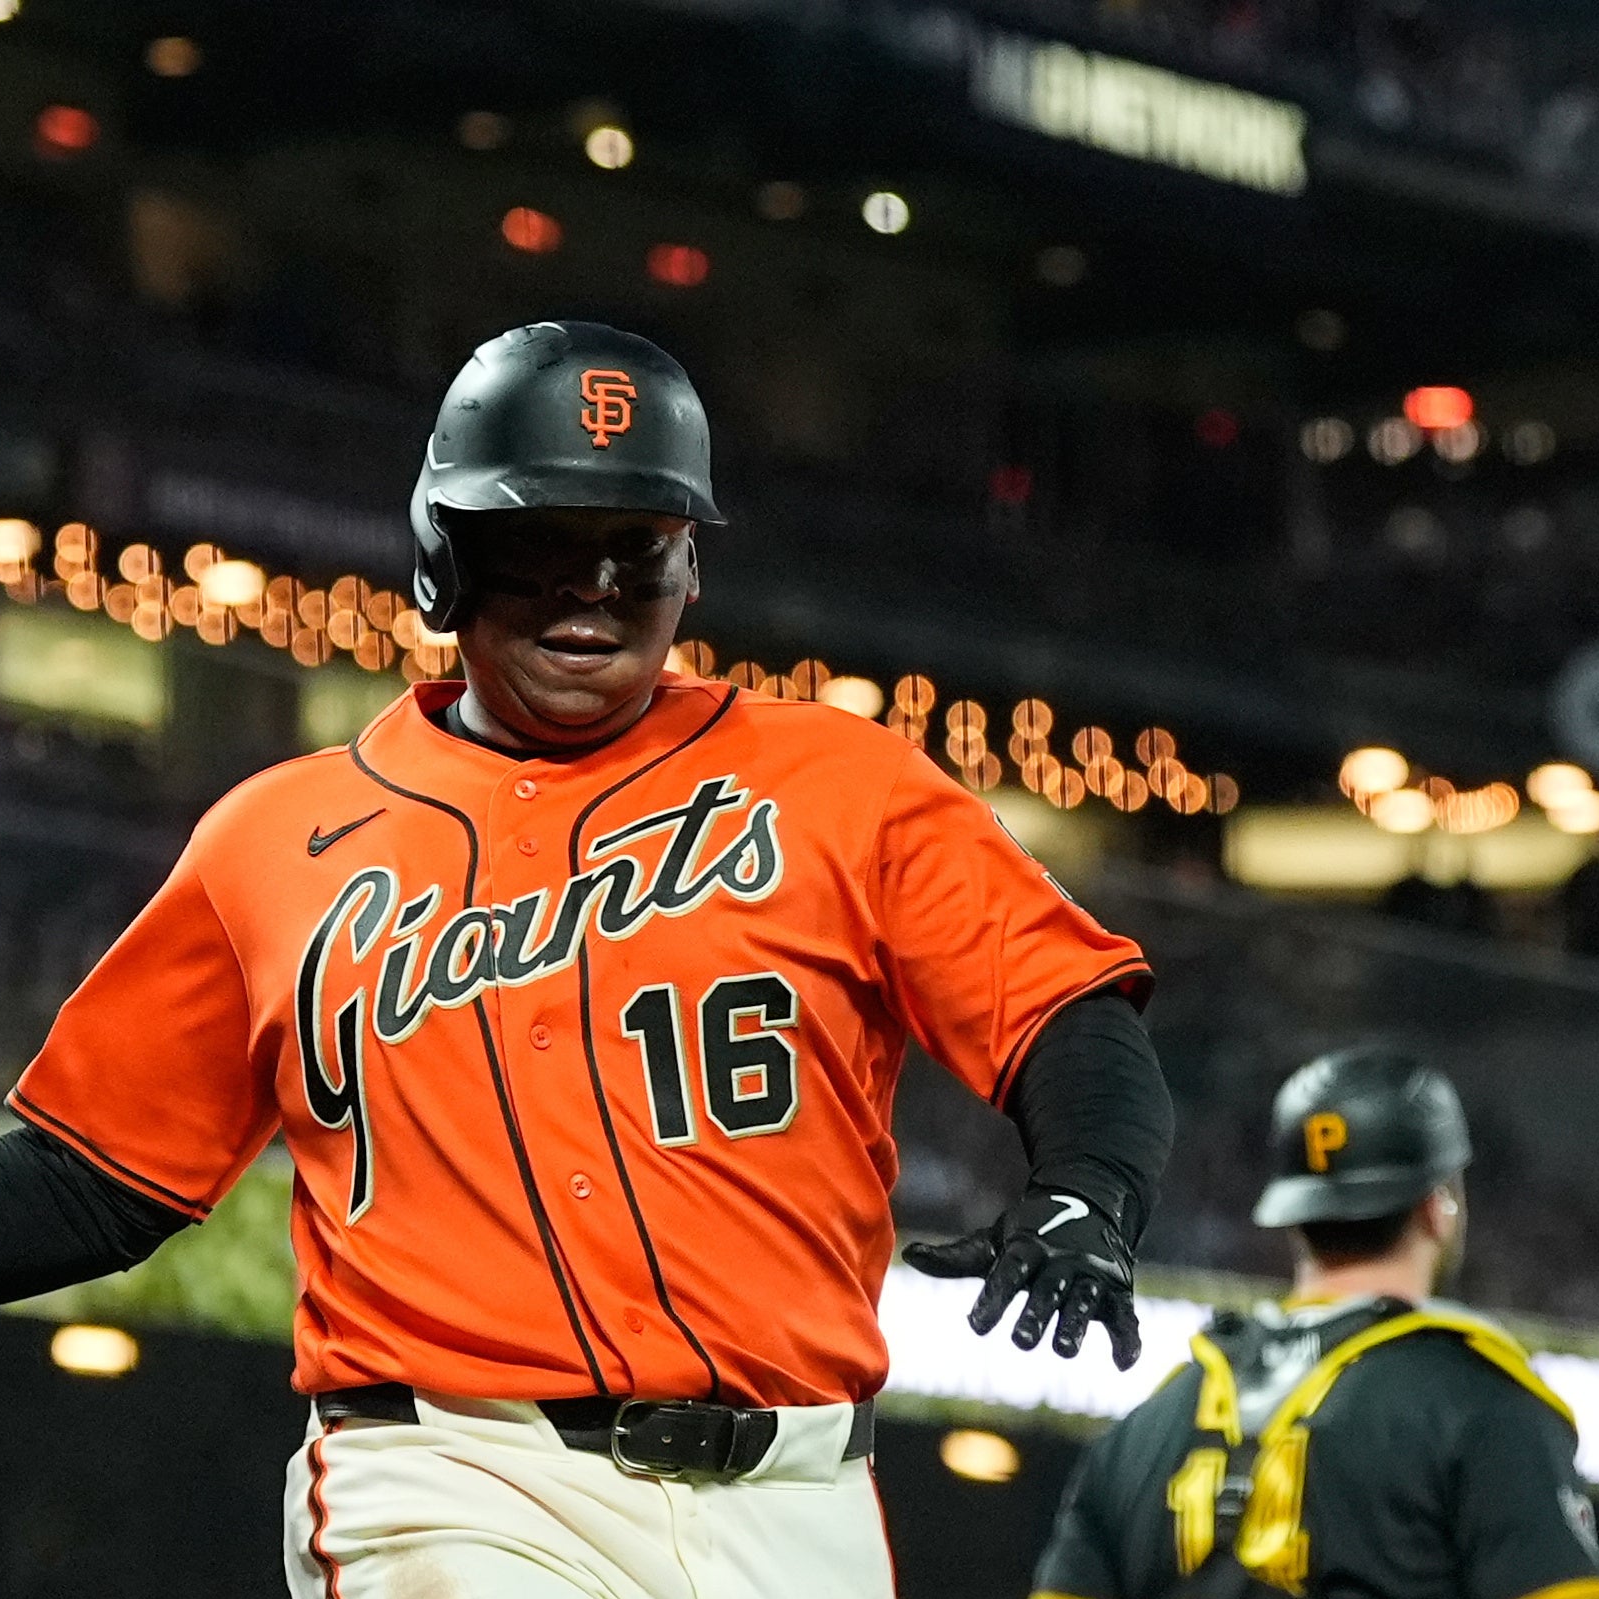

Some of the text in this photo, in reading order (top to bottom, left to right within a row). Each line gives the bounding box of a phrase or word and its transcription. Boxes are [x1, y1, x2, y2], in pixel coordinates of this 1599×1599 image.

[580, 368, 638, 449] SF
[296, 774, 783, 1227] Giants
[619, 971, 800, 1148] 16
[1303, 1111, 1350, 1174] P
